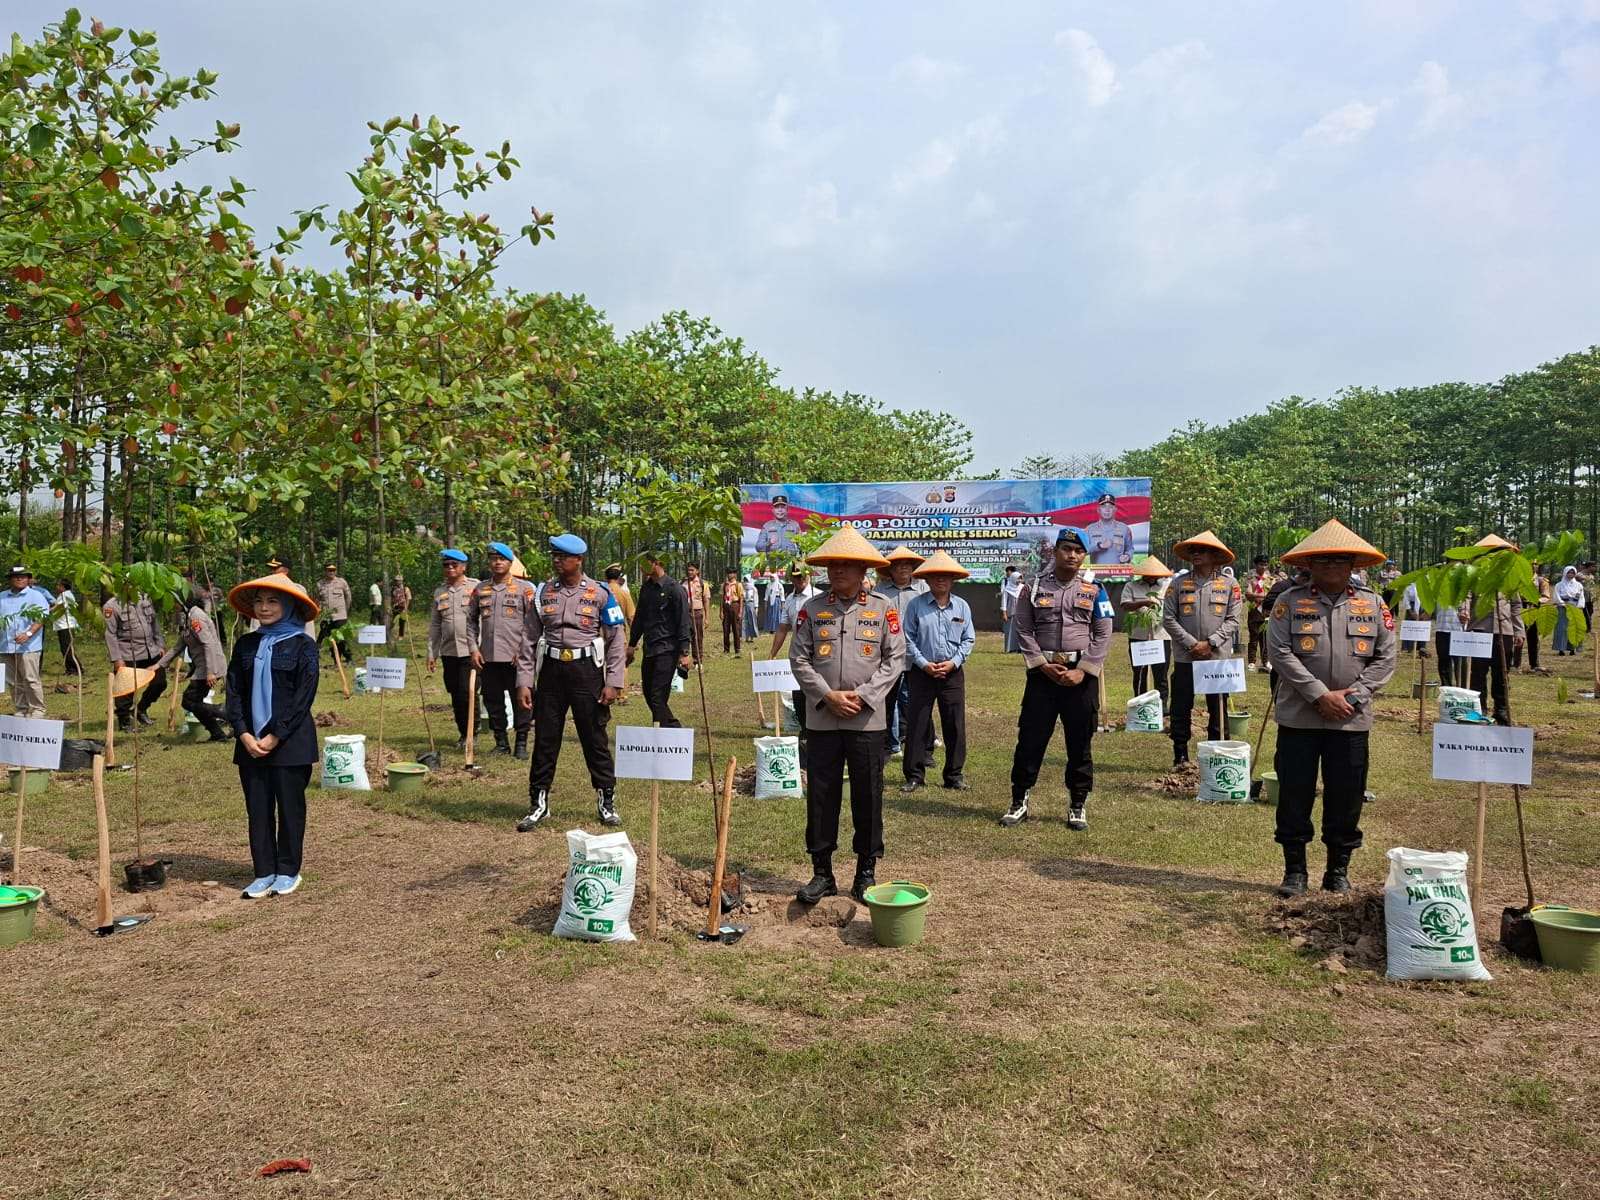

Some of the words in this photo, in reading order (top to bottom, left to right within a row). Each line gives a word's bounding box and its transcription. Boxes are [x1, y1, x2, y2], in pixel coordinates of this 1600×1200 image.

[899, 504, 983, 516] Penanaman
[876, 517, 943, 528] POHON
[949, 516, 1052, 527] SERENTAK
[866, 530, 919, 539] JAJARAN
[922, 529, 966, 540] POLRES
[968, 528, 1017, 539] SERANG
[953, 548, 1001, 556] INDONESIA
[858, 619, 879, 627] POLRI
[1349, 616, 1377, 624] POLRI
[25, 736, 57, 744] SERANG
[619, 744, 655, 753] KAPOLDA
[657, 746, 689, 754] BANTEN
[1439, 743, 1462, 751] WAKA
[1464, 744, 1491, 753] POLDA
[1492, 746, 1525, 754] BANTEN
[1405, 885, 1431, 906] PAK
